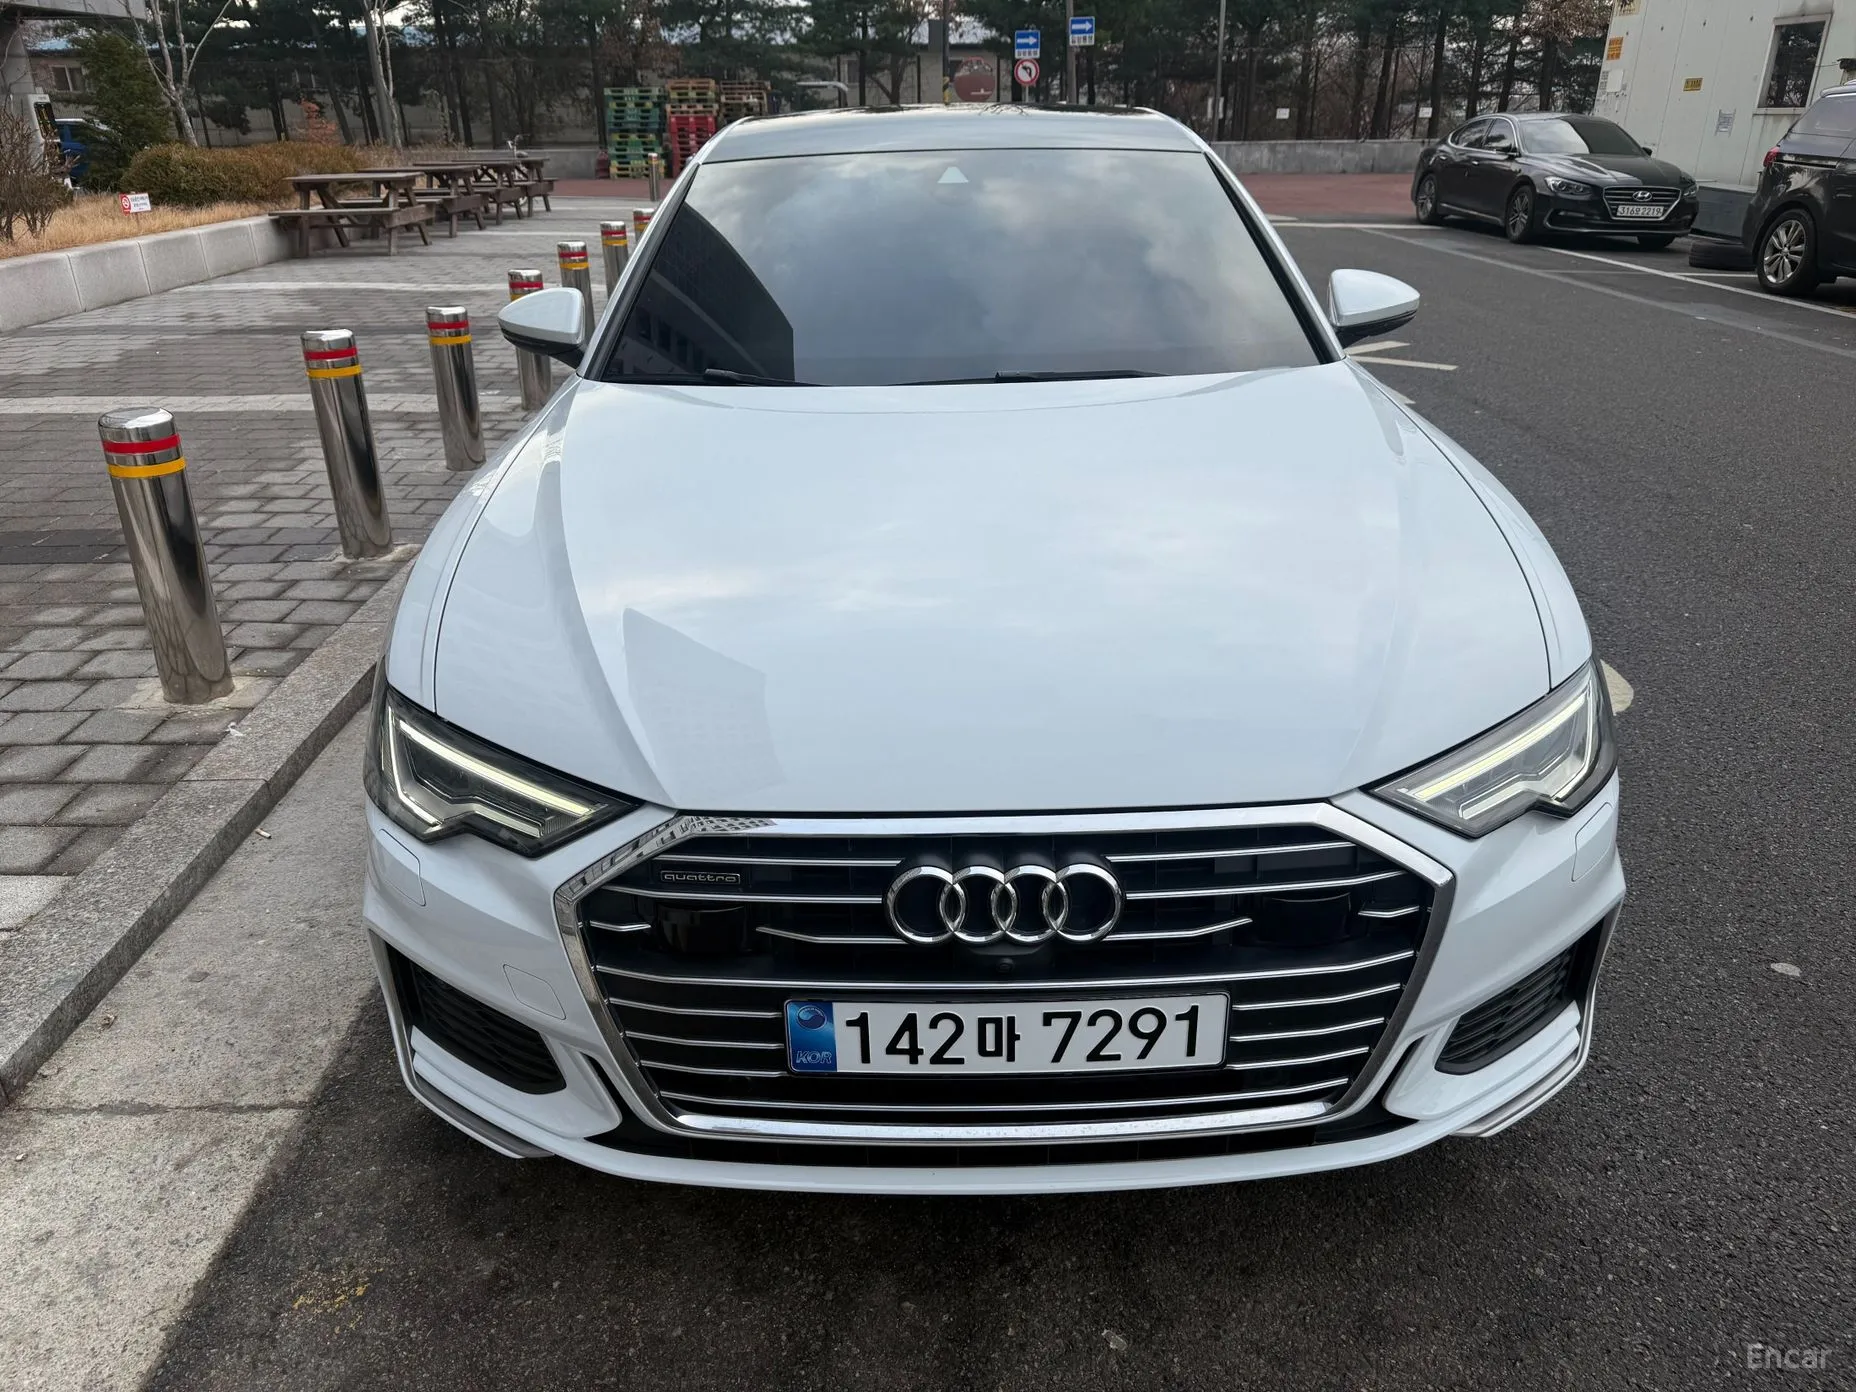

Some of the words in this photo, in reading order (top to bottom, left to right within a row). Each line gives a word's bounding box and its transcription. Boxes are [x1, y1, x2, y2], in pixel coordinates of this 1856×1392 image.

[663, 873, 737, 882] quattro
[845, 1009, 1021, 1066] 142마
[1042, 1004, 1200, 1064] 7291
[795, 1050, 833, 1064] KOR
